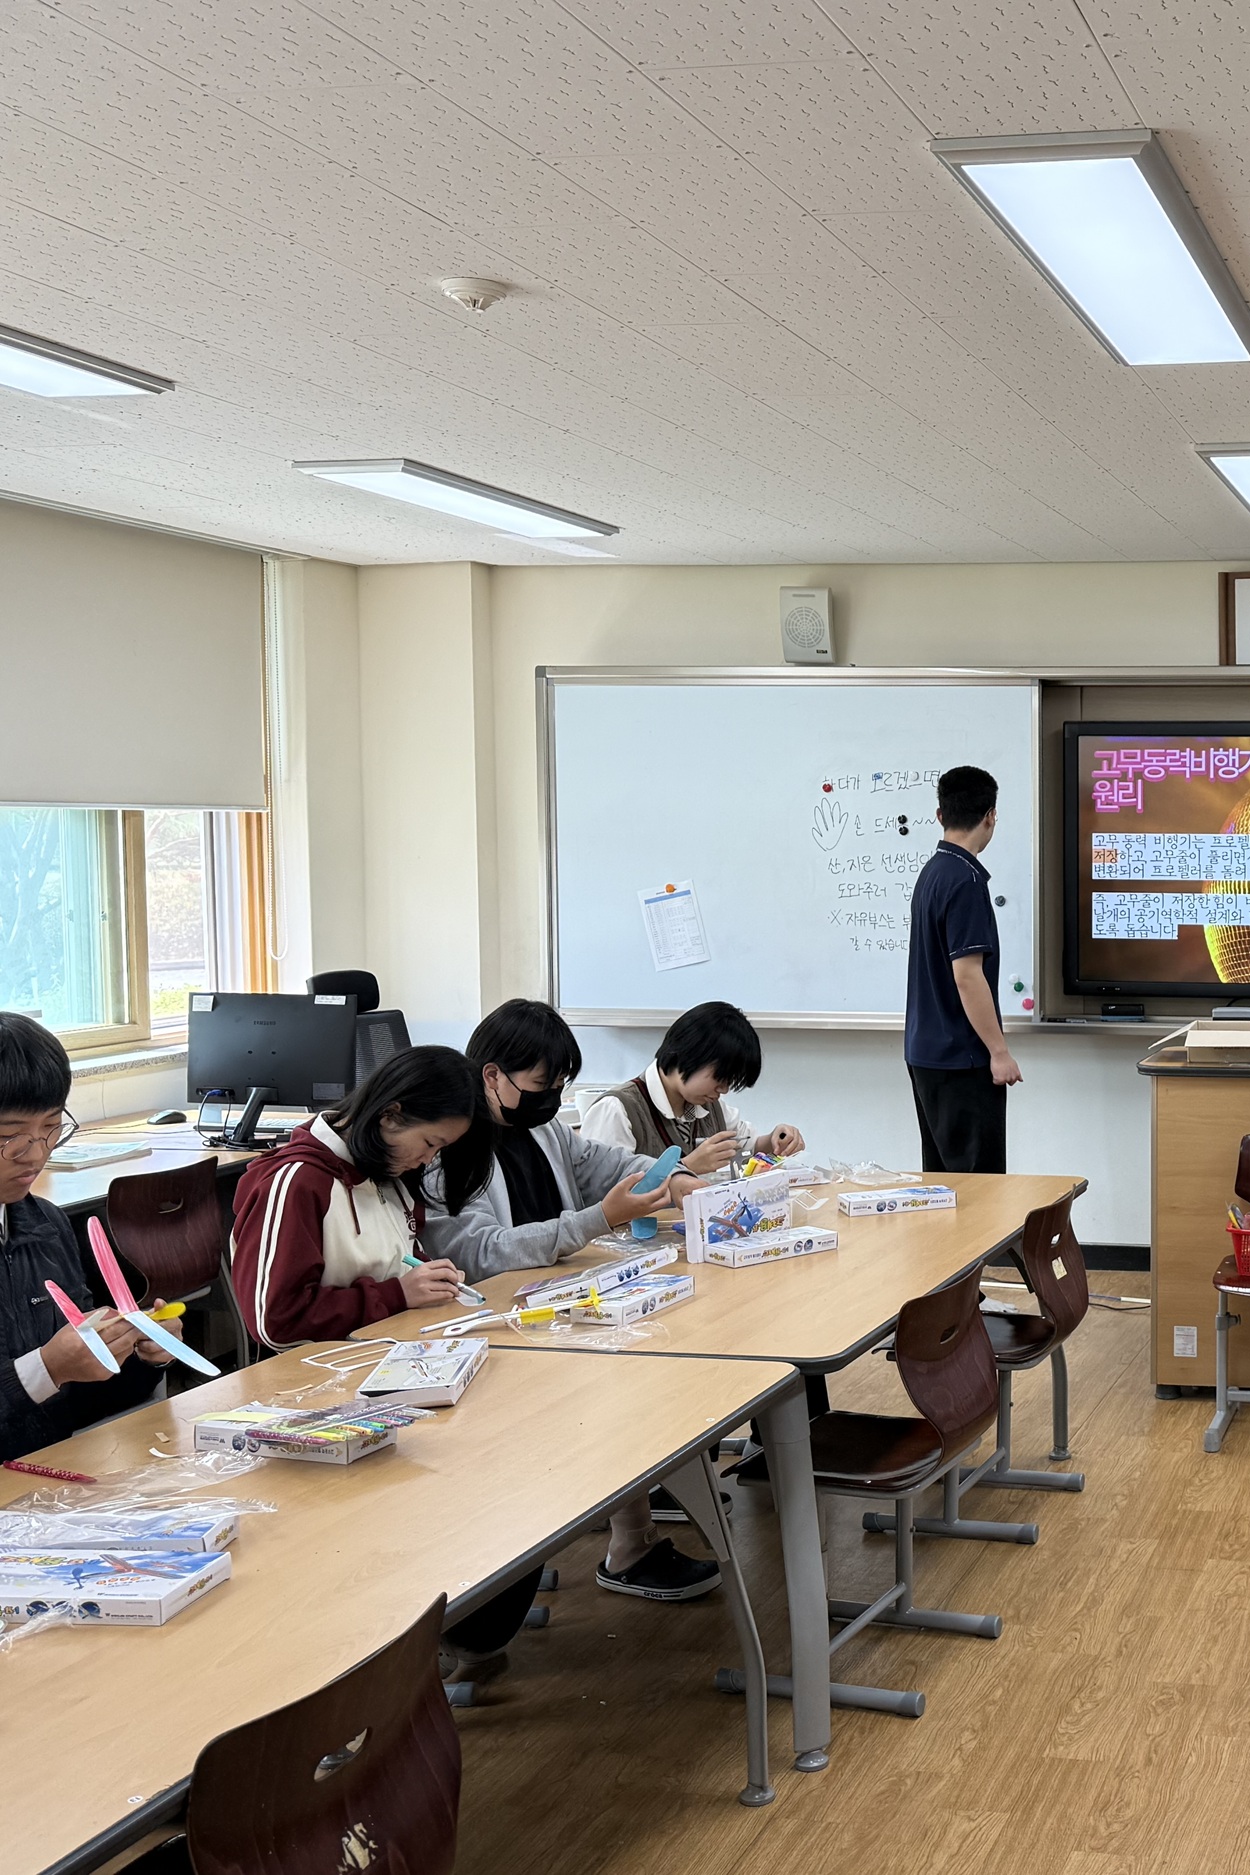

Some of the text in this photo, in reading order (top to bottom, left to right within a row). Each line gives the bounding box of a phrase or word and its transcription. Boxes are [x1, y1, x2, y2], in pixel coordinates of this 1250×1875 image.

[1092, 779, 1144, 813] 원리
[1094, 834, 1119, 850] 고무
[1122, 834, 1147, 850] 동력
[1154, 835, 1205, 850] 비행기는
[1094, 850, 1148, 864] 저장하고,
[1150, 850, 1201, 864] 고무줄이
[1094, 864, 1145, 879] 변환되어
[1151, 864, 1216, 879] 프로펠러를
[1221, 864, 1247, 879] 돌려
[838, 882, 887, 900] 도와주러
[1094, 894, 1109, 908] 즉,
[1114, 893, 1165, 909] 고무줄이
[1172, 893, 1210, 909] 저장한
[1213, 894, 1238, 909] 힘이
[845, 911, 896, 930] 자유부스는
[1094, 908, 1131, 923] 날개의
[1135, 908, 1198, 924] 공기역학적
[1205, 909, 1244, 924] 설계와
[1094, 923, 1178, 939] 도록 돕습니다.
